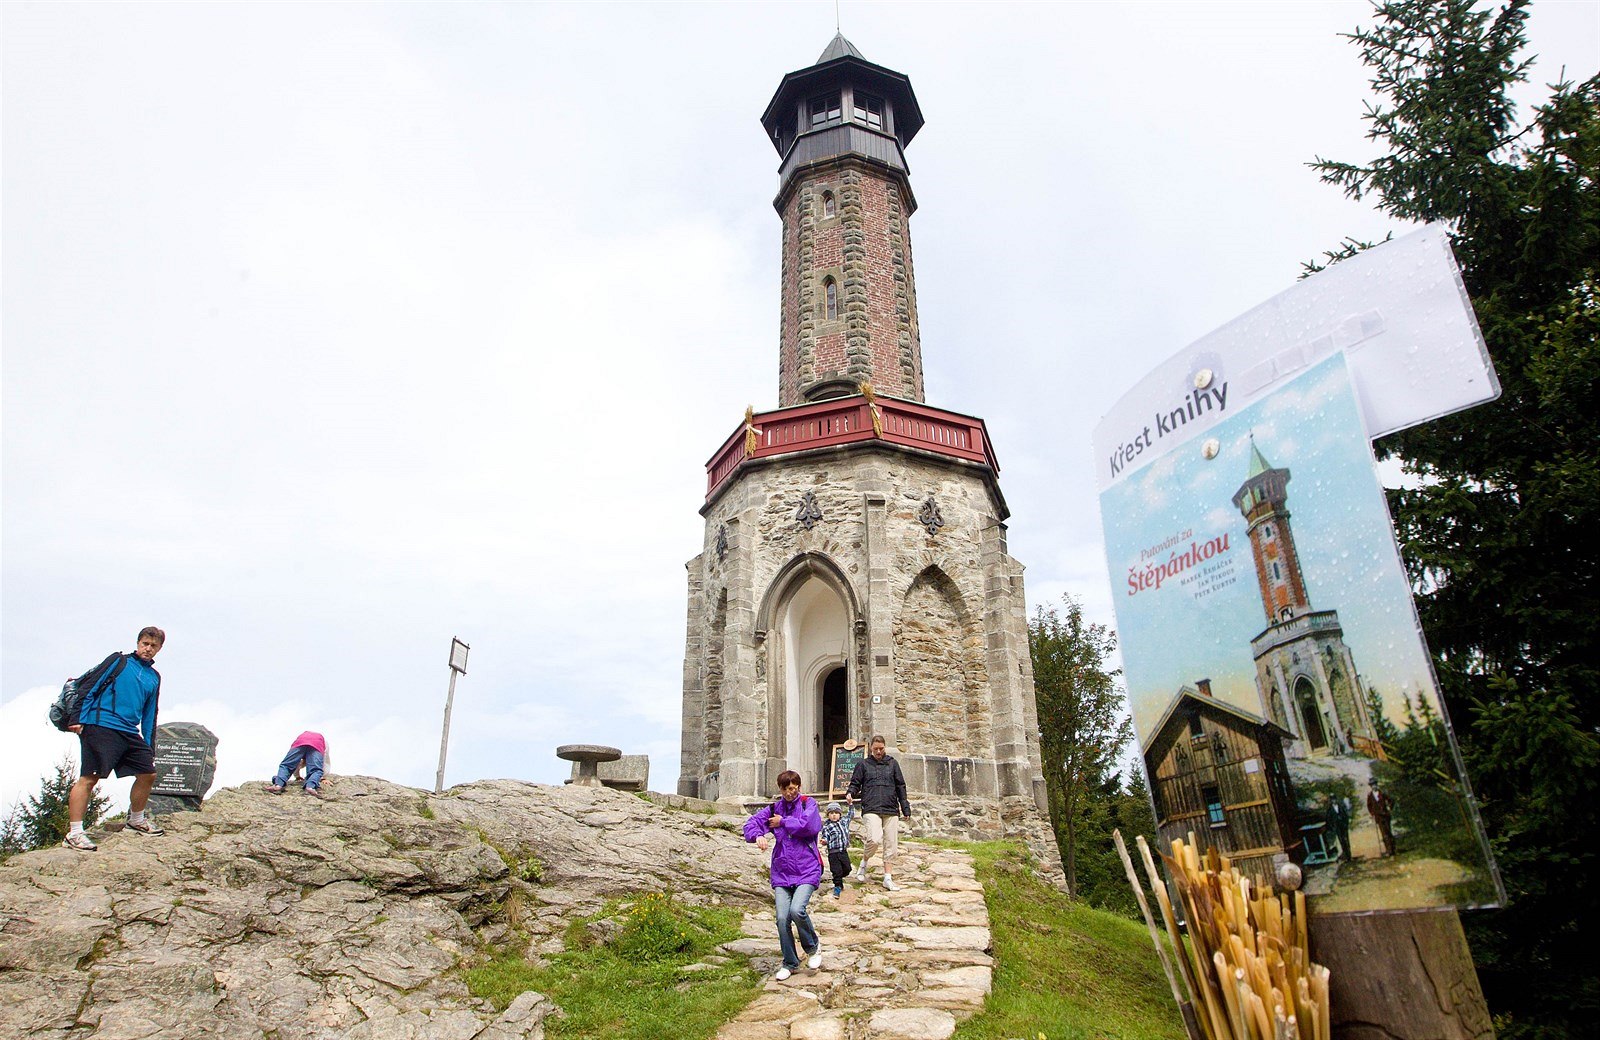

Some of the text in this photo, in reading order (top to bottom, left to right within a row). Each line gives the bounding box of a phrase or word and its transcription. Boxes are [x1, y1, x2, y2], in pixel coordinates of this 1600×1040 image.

[1109, 382, 1228, 478] Křest knihy
[1128, 533, 1230, 596] Štěpánkou
[1140, 528, 1192, 561] Putování za
